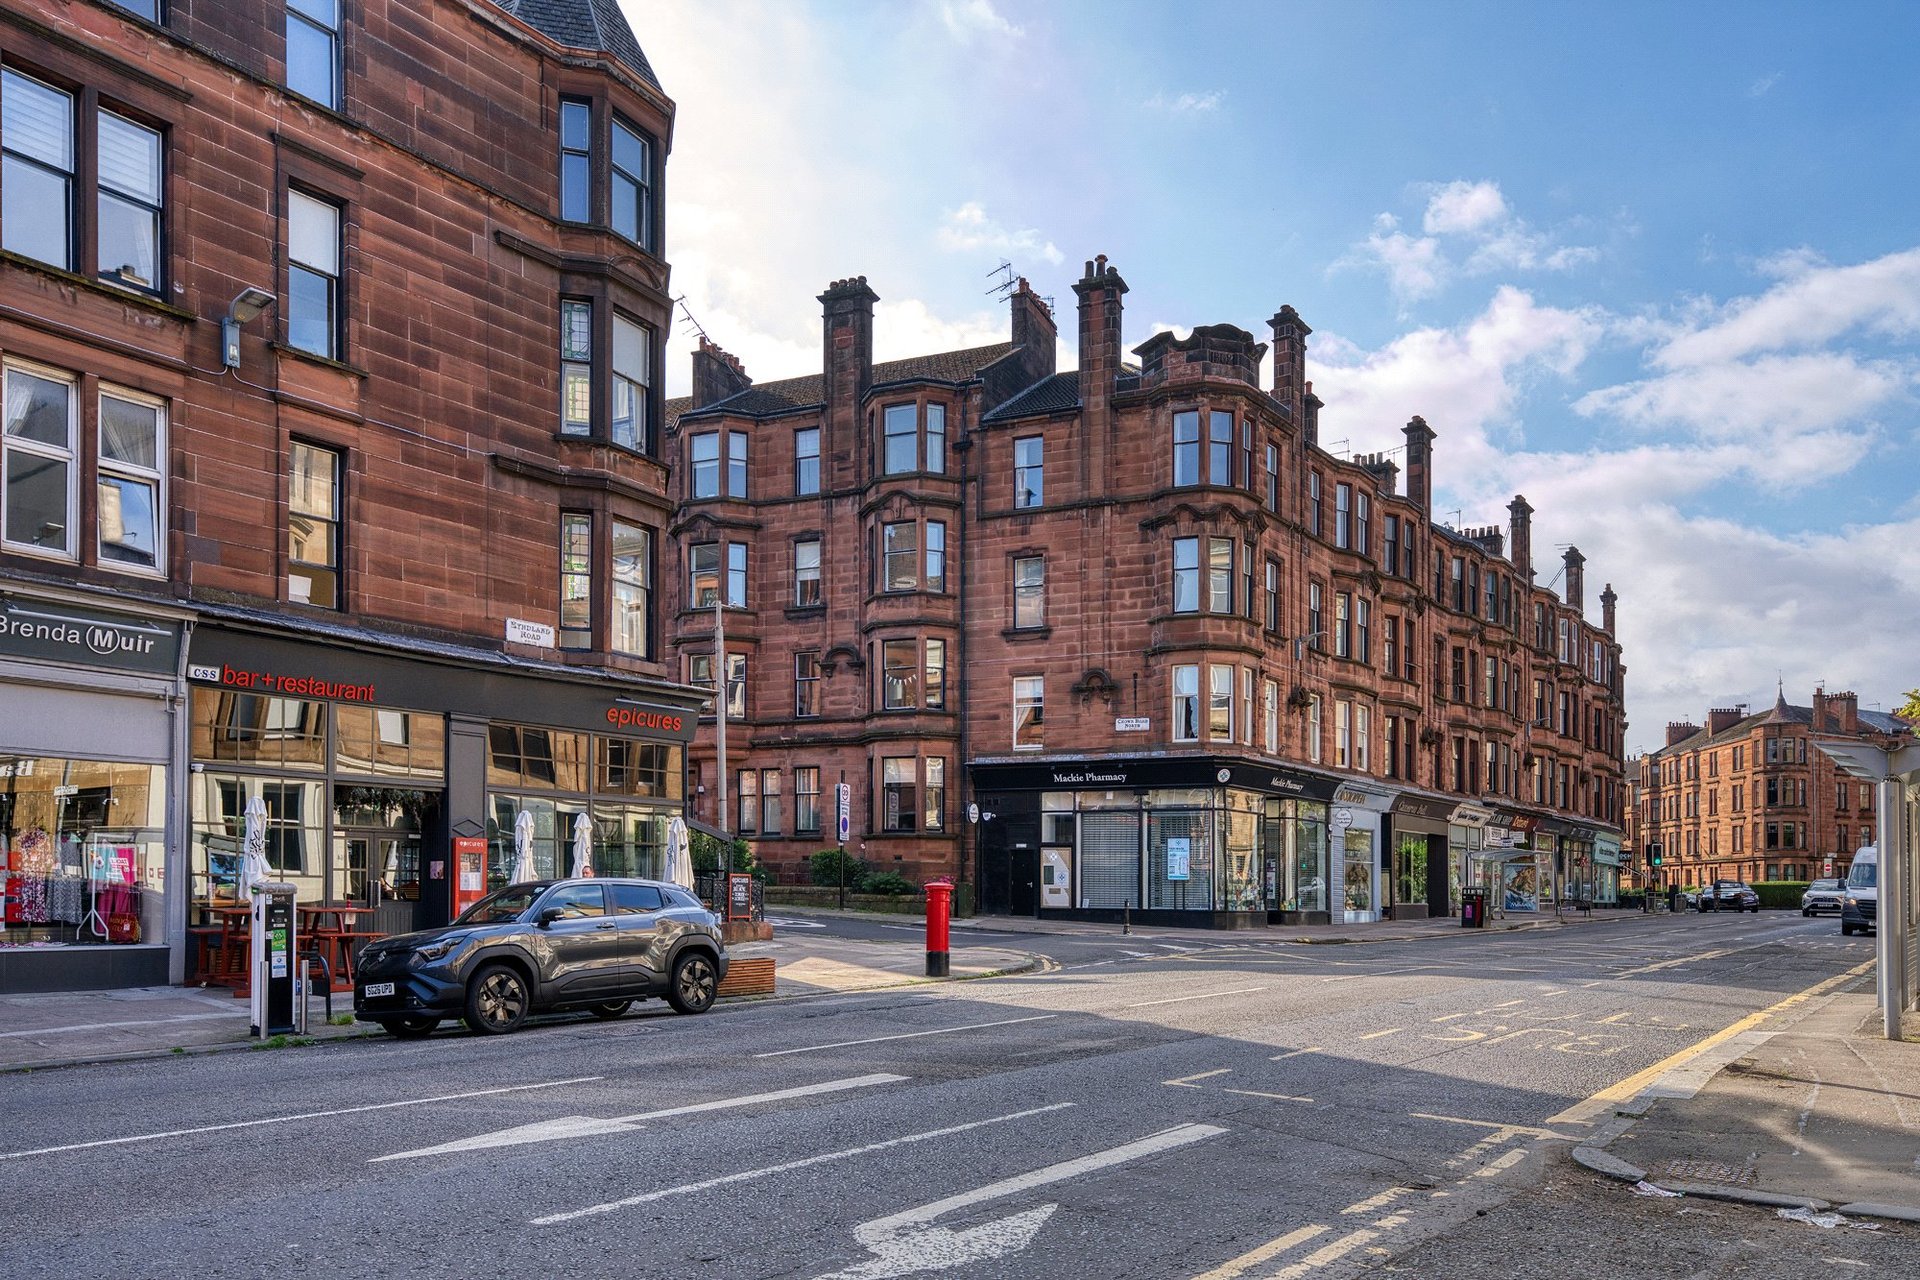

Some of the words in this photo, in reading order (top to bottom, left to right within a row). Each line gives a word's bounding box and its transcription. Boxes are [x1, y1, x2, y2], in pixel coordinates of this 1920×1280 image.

[92, 628, 155, 653] Muir
[606, 707, 682, 731] epicures
[1053, 773, 1084, 783] Mackie
[1085, 772, 1127, 783] Pharmacy
[367, 985, 381, 995] SG26
